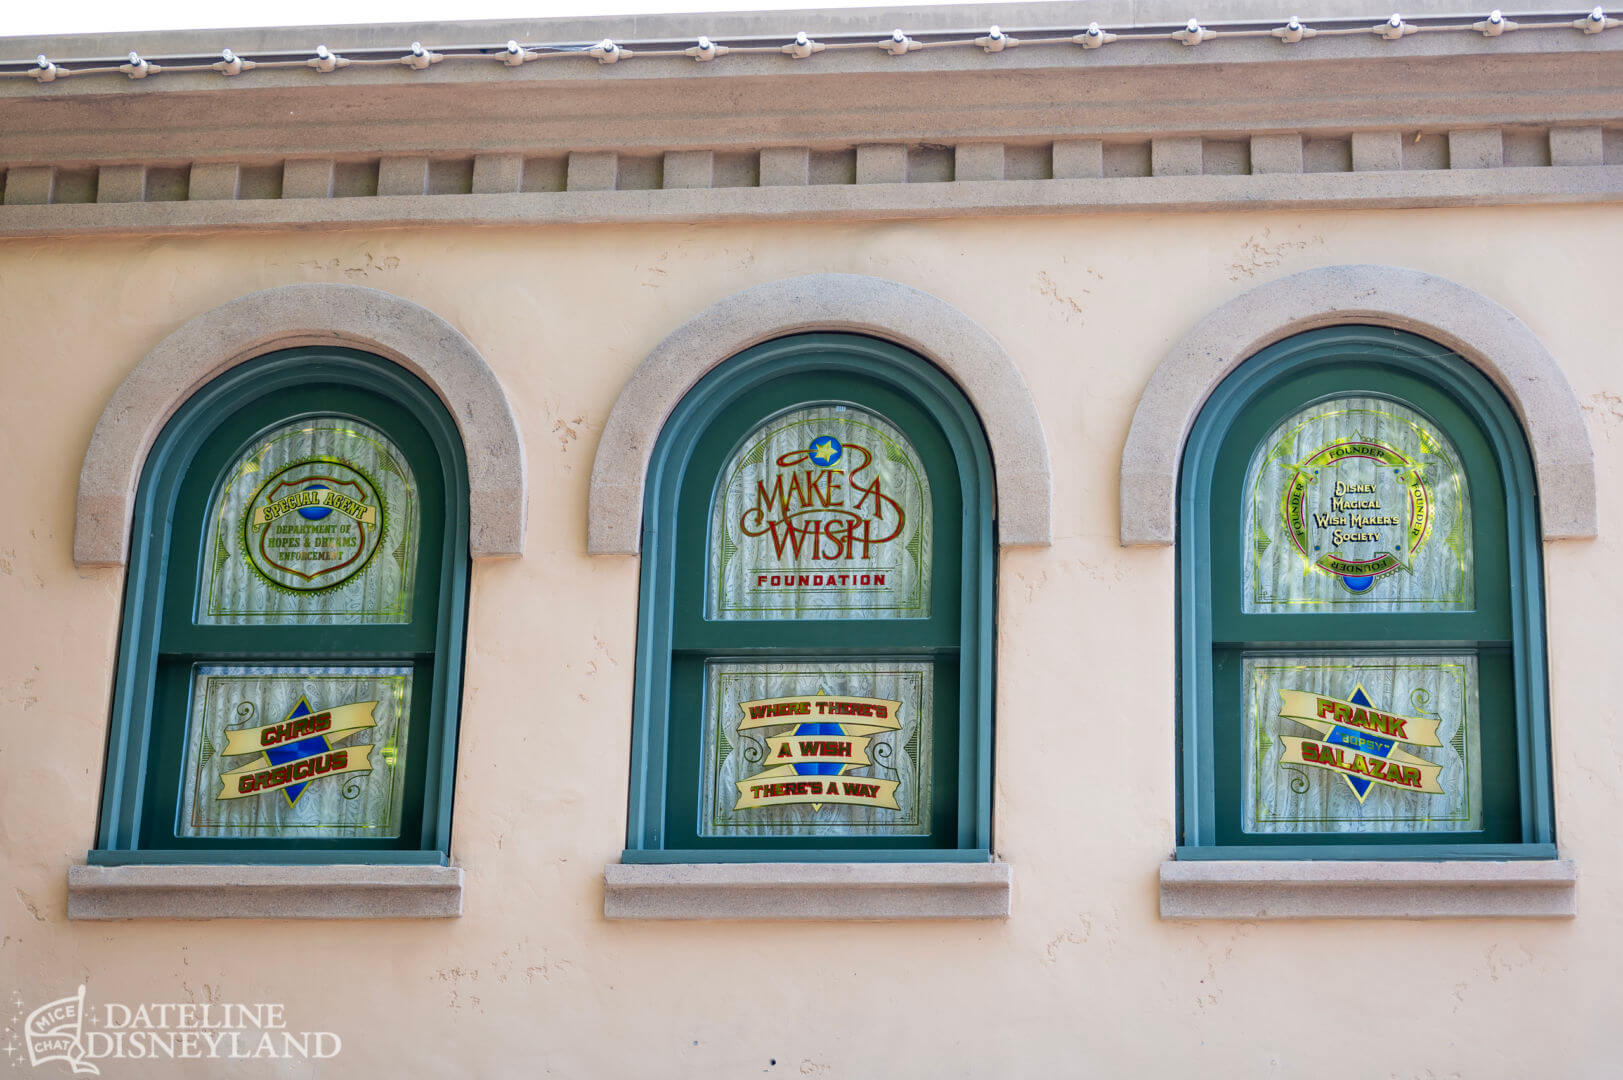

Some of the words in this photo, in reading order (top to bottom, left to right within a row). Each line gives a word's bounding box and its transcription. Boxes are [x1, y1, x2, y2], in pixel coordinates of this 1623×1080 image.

[1328, 446, 1385, 459] FOUNDER
[263, 491, 320, 521] SPECIAL
[324, 492, 368, 520] AGENT
[756, 469, 845, 526] MAKE
[853, 475, 884, 520] A
[1291, 483, 1305, 537] FOUNDER
[1411, 482, 1424, 537] FOUNDER
[275, 525, 337, 535] DEPARTMENT
[340, 524, 351, 534] OF
[268, 537, 301, 548] HOPES
[314, 537, 357, 548] DREAMS
[767, 519, 872, 561] WISH
[278, 551, 344, 561] ENFORCEMENT
[1331, 561, 1387, 573] FOUNDER
[757, 574, 886, 587] FOUNDATION
[748, 701, 812, 720] WHERE
[815, 701, 888, 719] THERE'S
[1316, 697, 1408, 740] FRANK
[260, 711, 332, 747] CHRIS
[777, 742, 793, 758] A
[798, 741, 852, 757] WISH
[1301, 741, 1423, 788] SALAZAR
[750, 781, 823, 799] THERE'S
[826, 781, 840, 795] A
[841, 782, 881, 798] WAY
